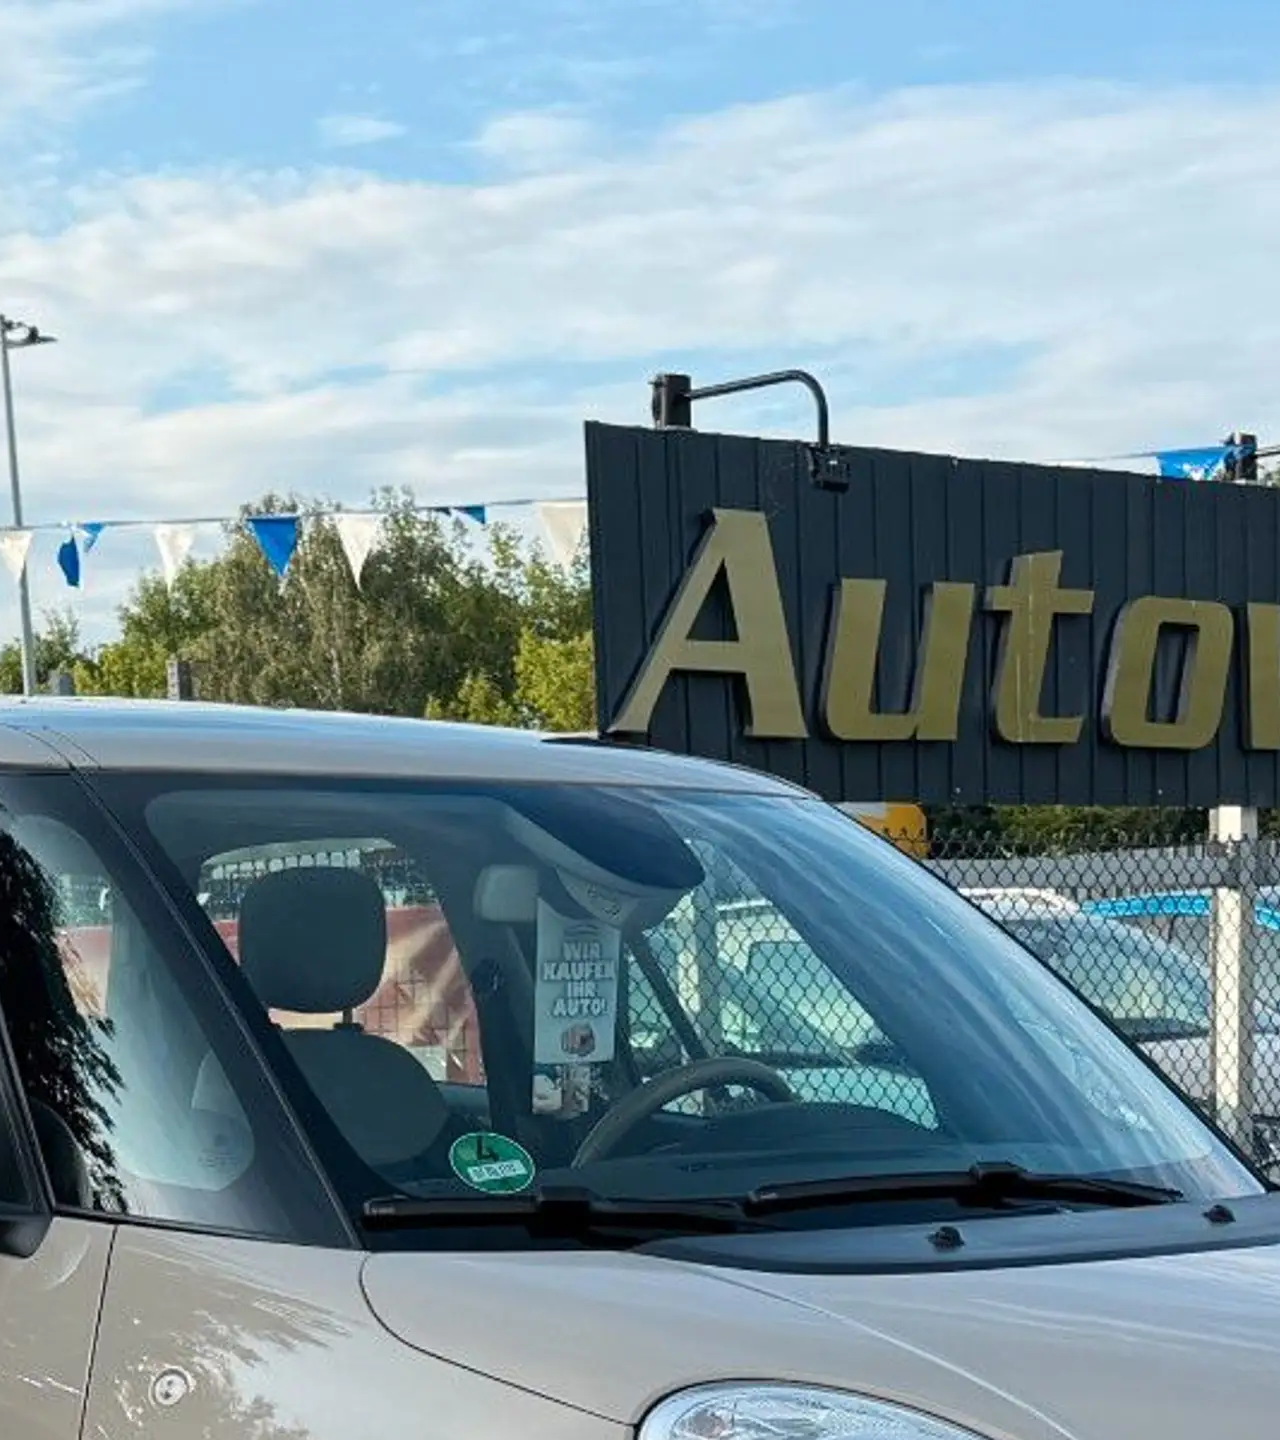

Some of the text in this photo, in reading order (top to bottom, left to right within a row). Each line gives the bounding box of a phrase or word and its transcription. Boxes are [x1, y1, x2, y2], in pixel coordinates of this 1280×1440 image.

[562, 941, 601, 960] WIR
[543, 959, 615, 981] KAUFEN
[566, 981, 596, 997] IHR
